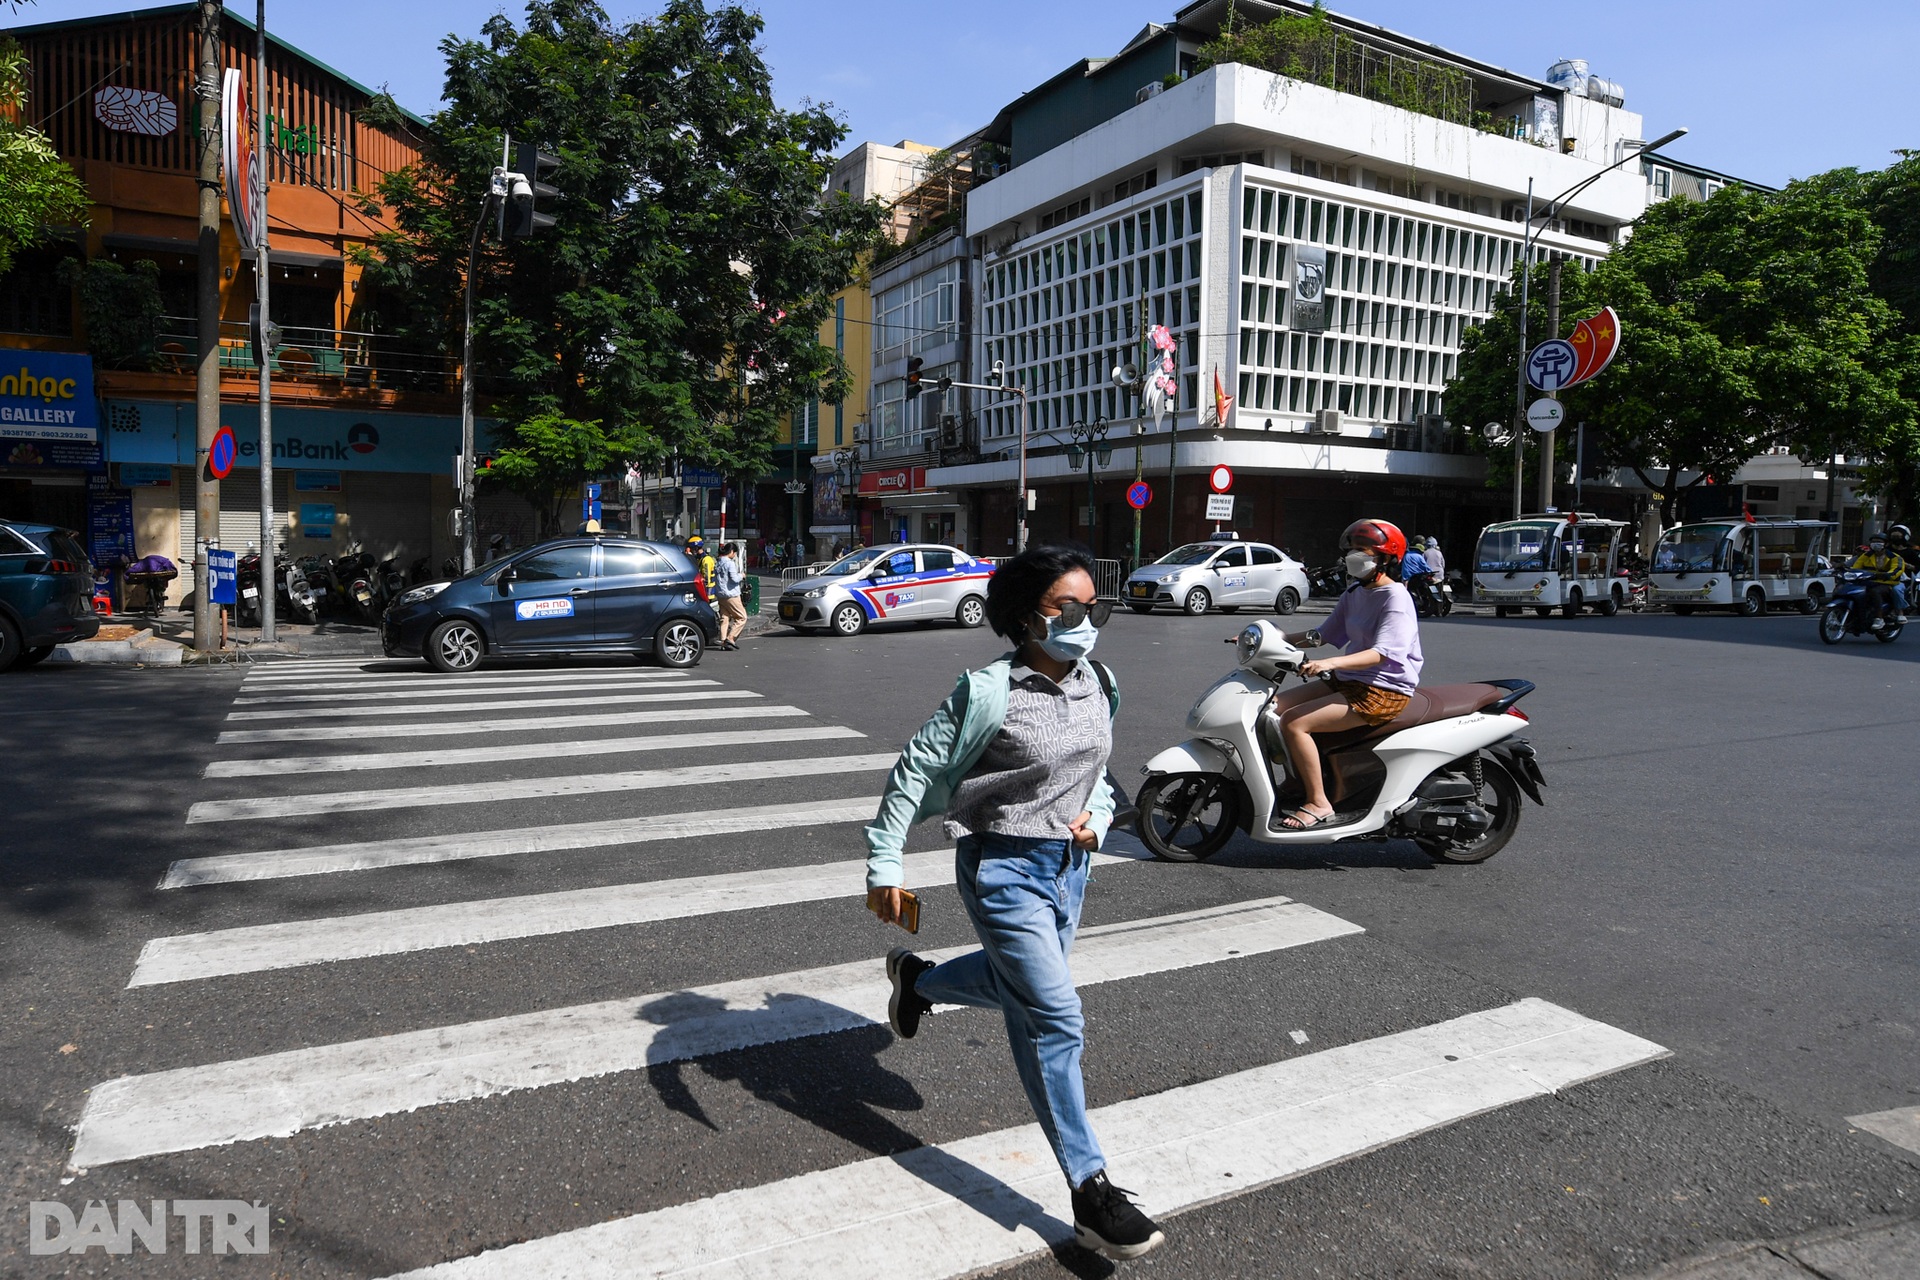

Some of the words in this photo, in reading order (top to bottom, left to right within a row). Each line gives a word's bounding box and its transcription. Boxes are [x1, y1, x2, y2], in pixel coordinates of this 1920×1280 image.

[1, 407, 76, 424] GALLERY
[41, 431, 89, 440] 0903.292.892
[685, 474, 698, 484] NGÔ
[878, 476, 897, 486] CIRCLE
[210, 569, 218, 600] P
[886, 592, 899, 608] G7
[899, 593, 915, 603] TAXI
